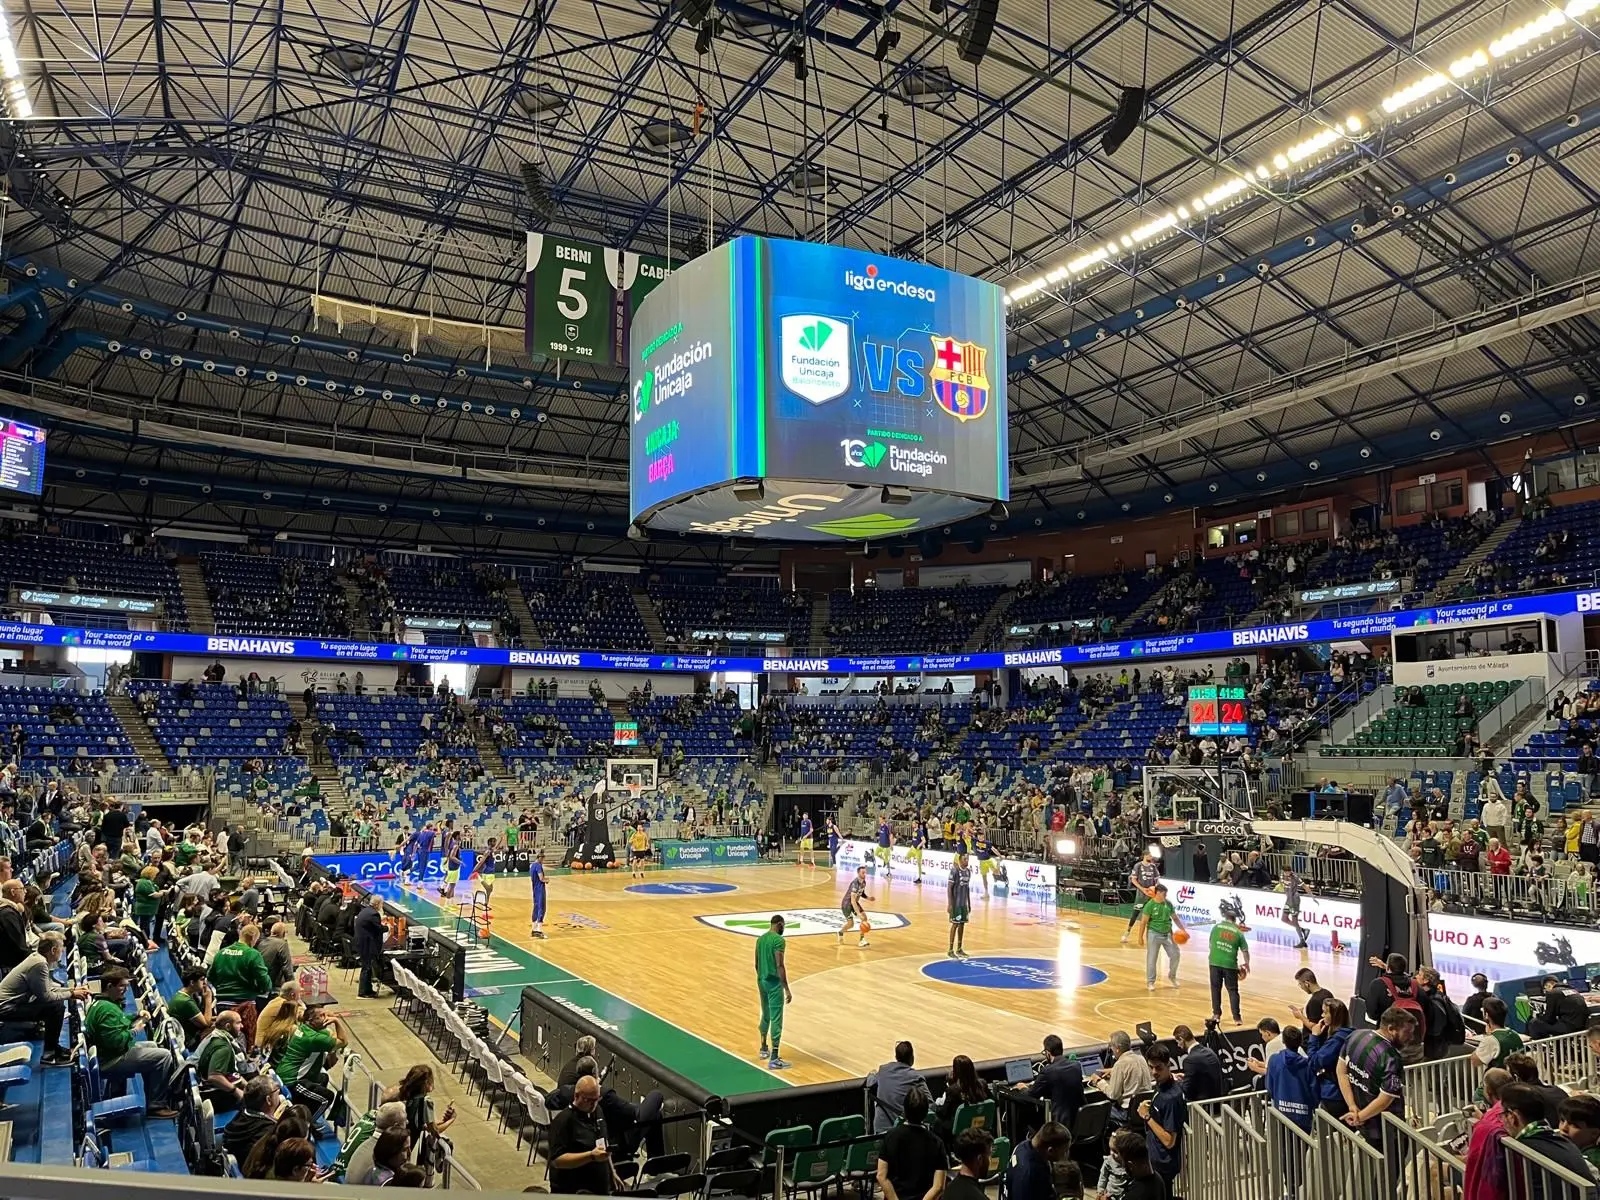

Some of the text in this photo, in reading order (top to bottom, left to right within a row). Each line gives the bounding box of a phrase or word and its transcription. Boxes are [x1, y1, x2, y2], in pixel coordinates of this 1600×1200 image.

[555, 245, 592, 264] BERNI
[845, 270, 936, 303] liga endesa
[557, 267, 588, 320] 5
[549, 342, 567, 352] 1999
[576, 346, 593, 356] 2012
[655, 341, 712, 386] Fundación
[791, 355, 840, 368] Fundación
[799, 367, 834, 380] Unicaja
[863, 341, 925, 397] VS
[654, 370, 693, 405] Unicaja
[867, 429, 891, 439] PARTIDO
[891, 431, 919, 441] DEDICADO
[889, 445, 947, 465] Fundación
[647, 453, 674, 484] BARÇA
[889, 458, 933, 477] Unicaja
[1436, 603, 1513, 618] Your second plce
[1332, 615, 1396, 628] Tu segundo lugar
[0, 625, 44, 635] undo lugar
[84, 630, 155, 642] Your second plce
[1232, 625, 1309, 646] BENAHAVIS
[1350, 624, 1397, 635] en el mundo
[6, 632, 15, 640] el
[15, 634, 44, 642] mundo
[1158, 638, 1177, 646] second
[1177, 636, 1194, 645] plce
[207, 637, 295, 654] BENAHAVIS
[320, 642, 378, 652] Tu segundo lugar
[1085, 646, 1106, 654] segundo
[1106, 644, 1120, 653] lugar
[1161, 644, 1178, 652] world
[509, 651, 581, 666] BENAHAVIS
[609, 655, 632, 663] segundo
[1004, 650, 1062, 665] BENAHAVIS
[1102, 650, 1120, 658] mundo
[763, 660, 829, 671] BENAHAVIS
[880, 658, 896, 666] lugar
[1437, 664, 1477, 673] Ayuntamiento
[1487, 661, 1509, 671] Málaga
[1190, 702, 1216, 724] 24
[1219, 702, 1243, 724] 24
[1203, 823, 1245, 835] endesa
[679, 845, 709, 854] Fundación
[726, 843, 755, 852] Fundación
[727, 849, 749, 858] Unicaja
[679, 851, 702, 860] Unicaja
[1191, 905, 1211, 916] Hnos.
[1255, 904, 1363, 930] MATULA GRA
[1472, 934, 1485, 949] A
